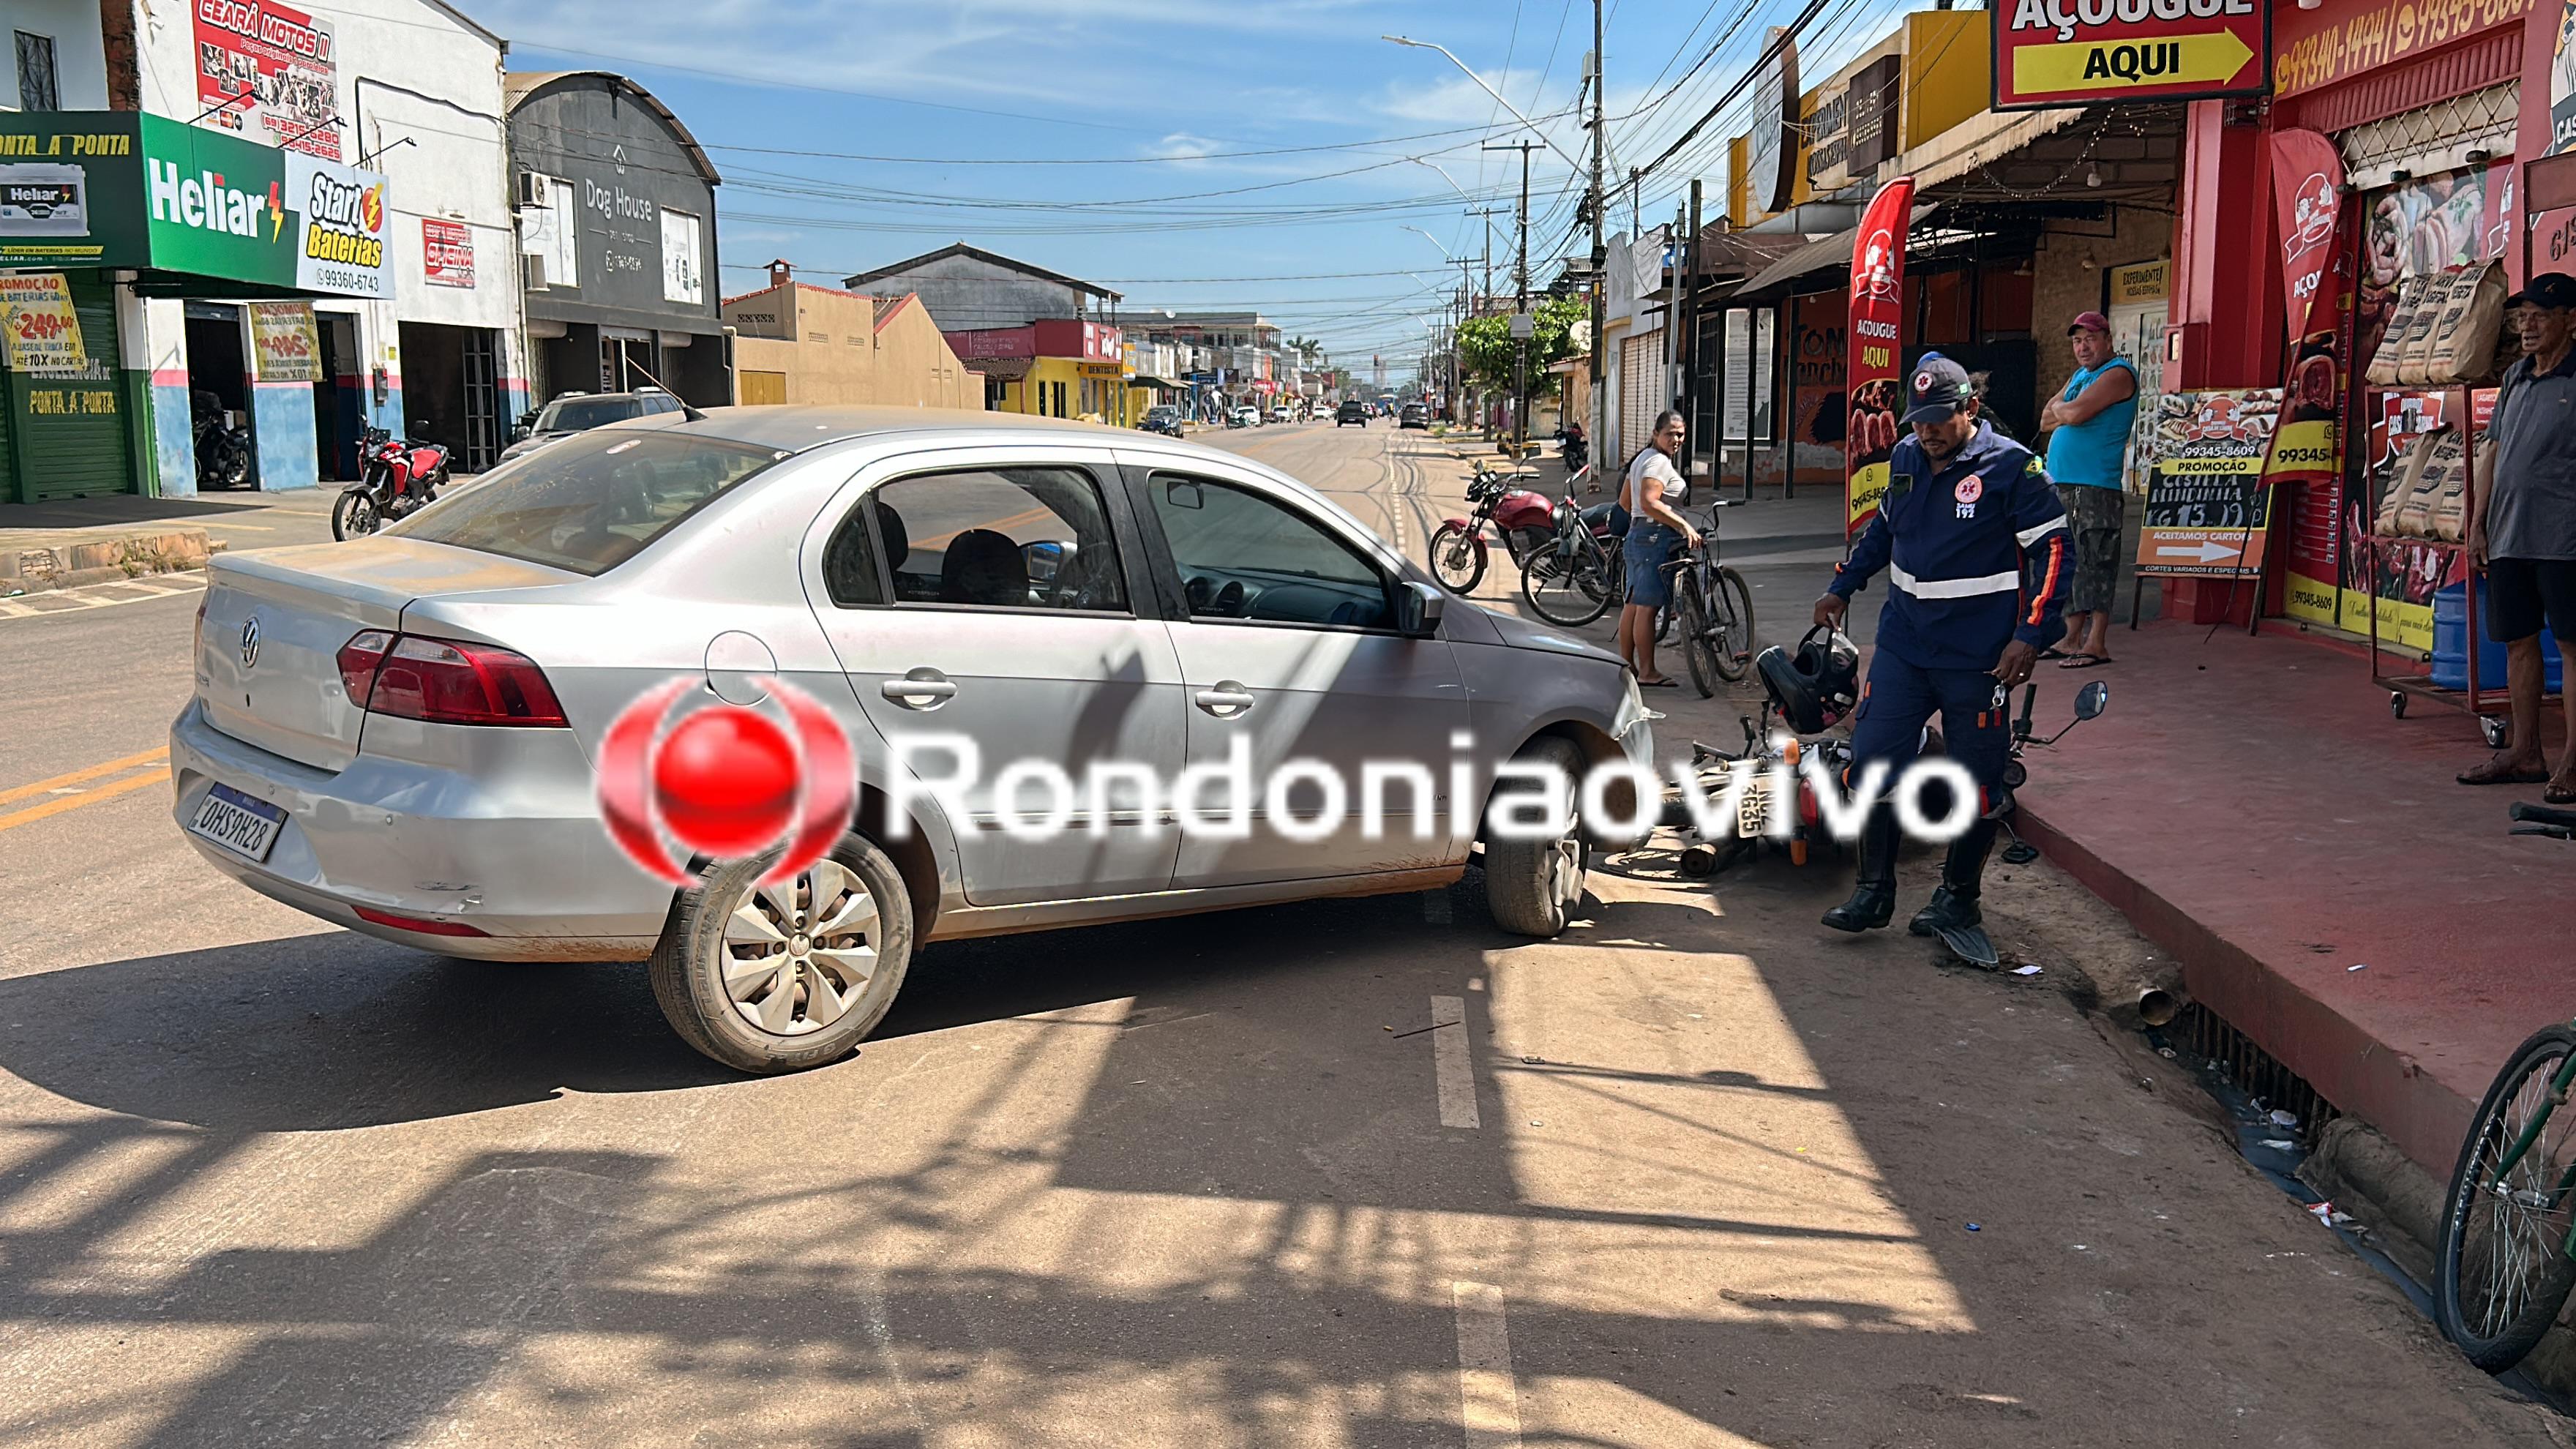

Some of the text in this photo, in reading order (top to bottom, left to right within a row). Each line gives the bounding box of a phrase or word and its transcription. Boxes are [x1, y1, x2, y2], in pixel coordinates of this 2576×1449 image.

[261, 12, 318, 58] MOTOS
[2083, 42, 2180, 83] AQUI
[0, 135, 130, 155] NTA A PONTA
[10, 187, 59, 201] Heliar
[149, 157, 266, 238] Heliar
[310, 172, 362, 228] Start
[585, 178, 652, 222] Dog House
[306, 222, 383, 269] Baterias
[325, 271, 378, 292] 99360-6743
[1857, 318, 1897, 340] AÇOUGUE
[29, 354, 48, 366] 10X
[1862, 345, 1890, 370] AQUI
[1088, 366, 1119, 375] DENTISTA
[30, 391, 64, 414] PONTA
[83, 391, 116, 414] PONTA
[2183, 446, 2256, 457] 99345-8609
[2177, 458, 2247, 473] PROMOÇÃO
[1955, 509, 1975, 519] 192
[2153, 532, 2206, 540] ACEITAMOS
[2294, 591, 2332, 610] 99345-8609
